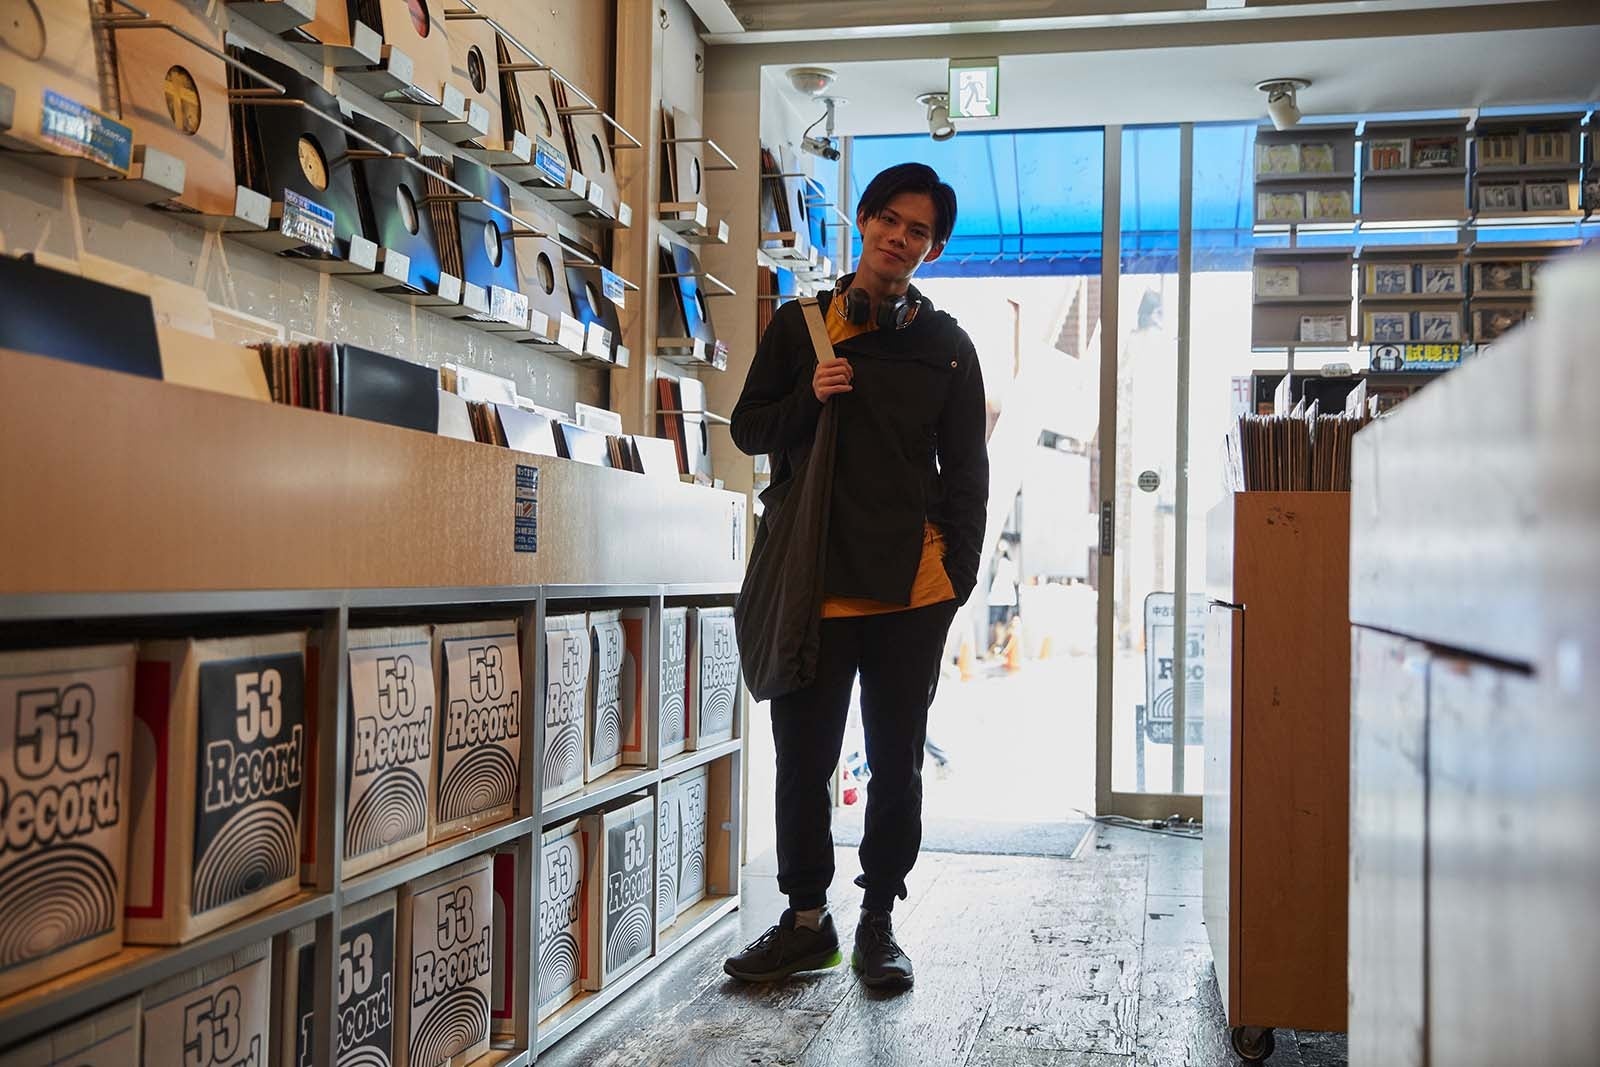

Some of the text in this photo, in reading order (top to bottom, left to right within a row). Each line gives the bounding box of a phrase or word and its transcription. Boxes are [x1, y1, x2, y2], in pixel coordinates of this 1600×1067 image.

[468, 644, 505, 703] 53
[562, 636, 583, 687] 53
[669, 622, 683, 662] 53
[713, 622, 733, 660] 53
[235, 668, 283, 744] 53
[376, 655, 416, 721] 53
[14, 683, 95, 781] 53
[355, 706, 432, 776] Record
[446, 691, 520, 751] Record
[205, 724, 303, 812] Record
[0, 752, 120, 856] ecord
[659, 800, 670, 842] 3
[687, 783, 702, 825] 53
[546, 845, 572, 901] 53
[624, 824, 645, 872] 53
[540, 880, 581, 945] Record
[608, 854, 654, 915] Record
[437, 885, 473, 950] 53
[338, 933, 373, 1006] 53
[413, 925, 491, 1009] Record
[183, 985, 241, 1067] 53
